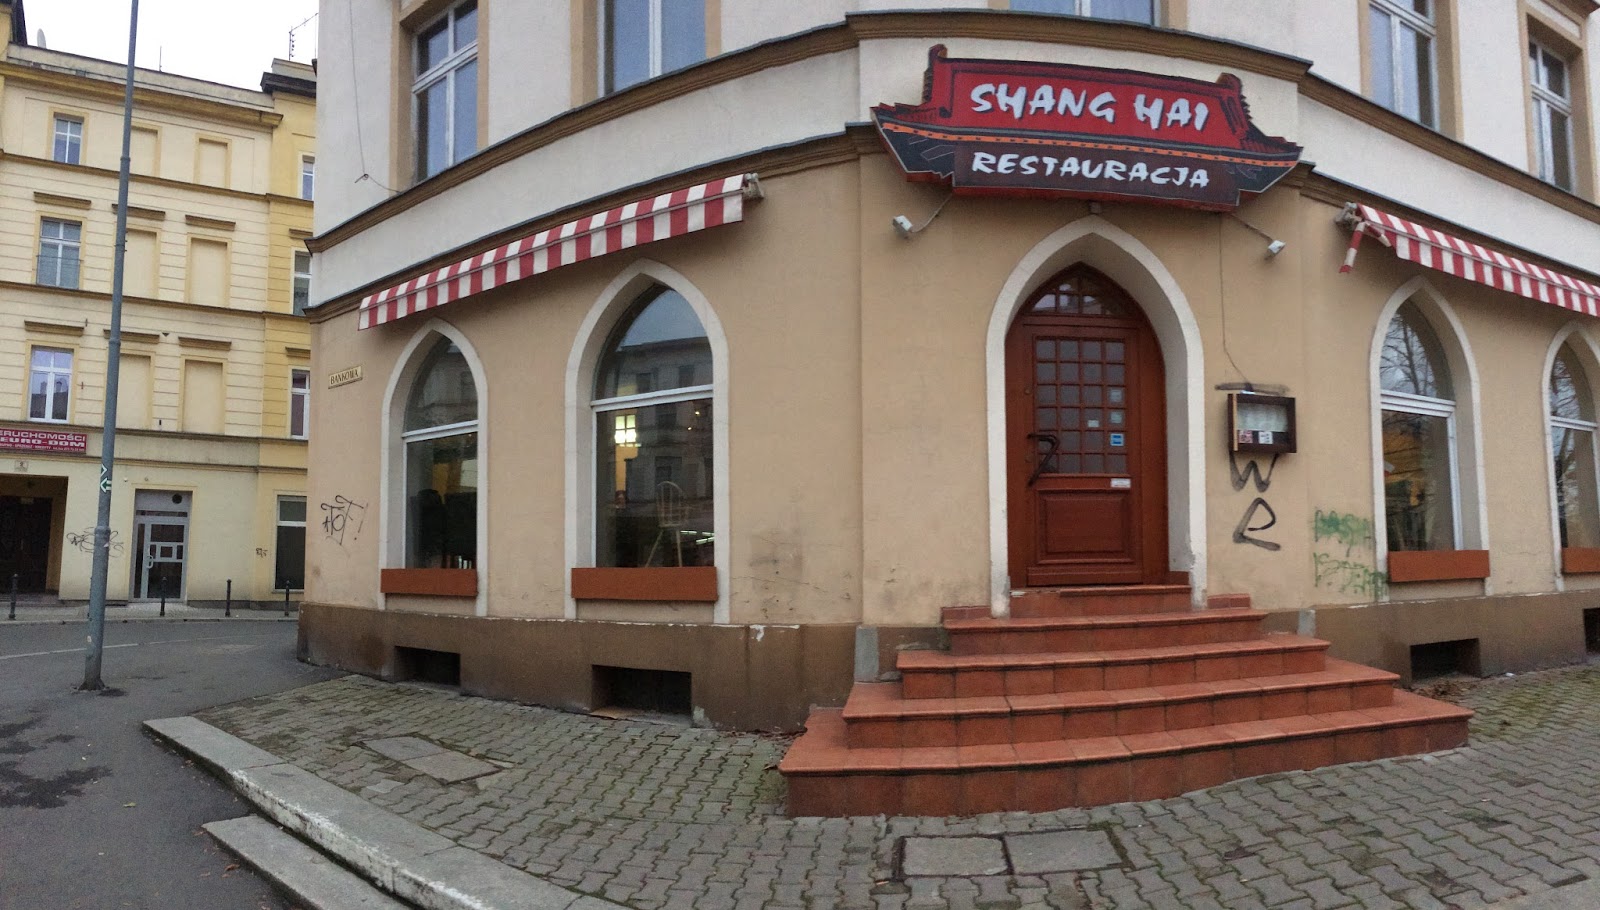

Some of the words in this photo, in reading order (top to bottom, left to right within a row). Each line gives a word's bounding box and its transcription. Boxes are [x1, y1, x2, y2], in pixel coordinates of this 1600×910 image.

[970, 83, 1117, 123] SHANG
[1134, 93, 1208, 130] HAI
[972, 152, 1209, 188] RESTAURACJA
